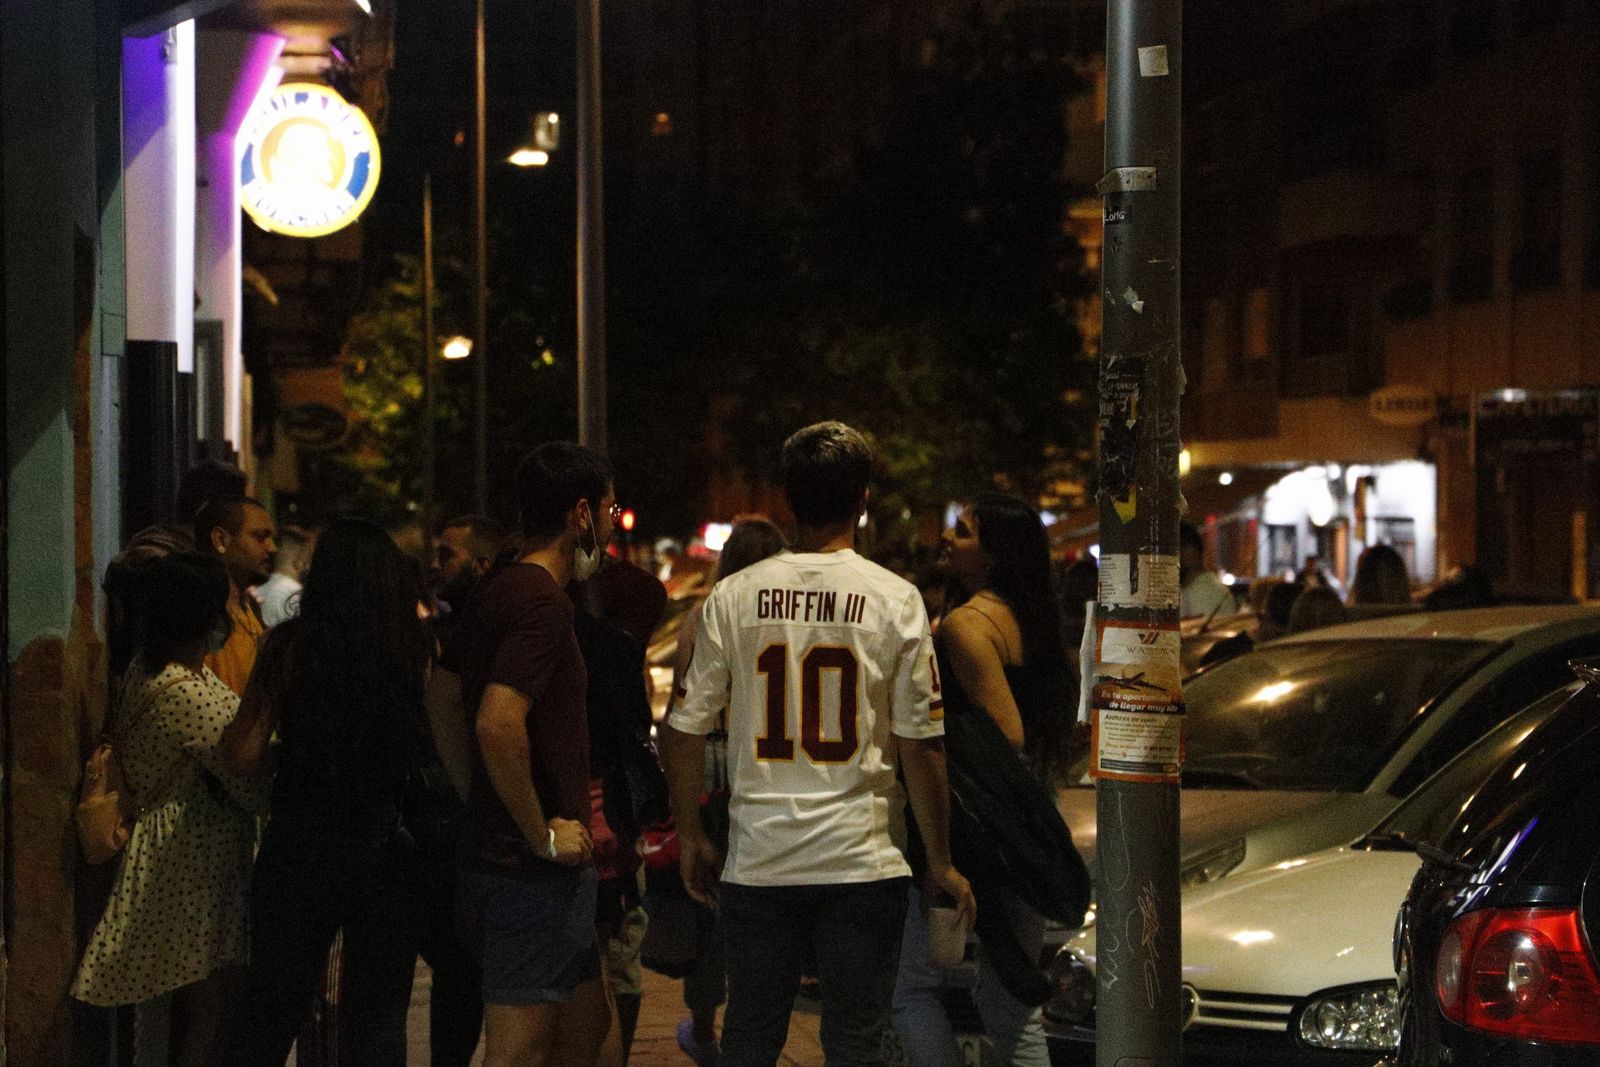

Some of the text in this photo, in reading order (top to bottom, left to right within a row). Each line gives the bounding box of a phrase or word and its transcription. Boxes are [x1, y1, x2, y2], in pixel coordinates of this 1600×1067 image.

[757, 588, 866, 624] GRIFFIN III
[755, 641, 861, 766] 10
[1109, 701, 1119, 709] de
[1119, 702, 1147, 712] llegar
